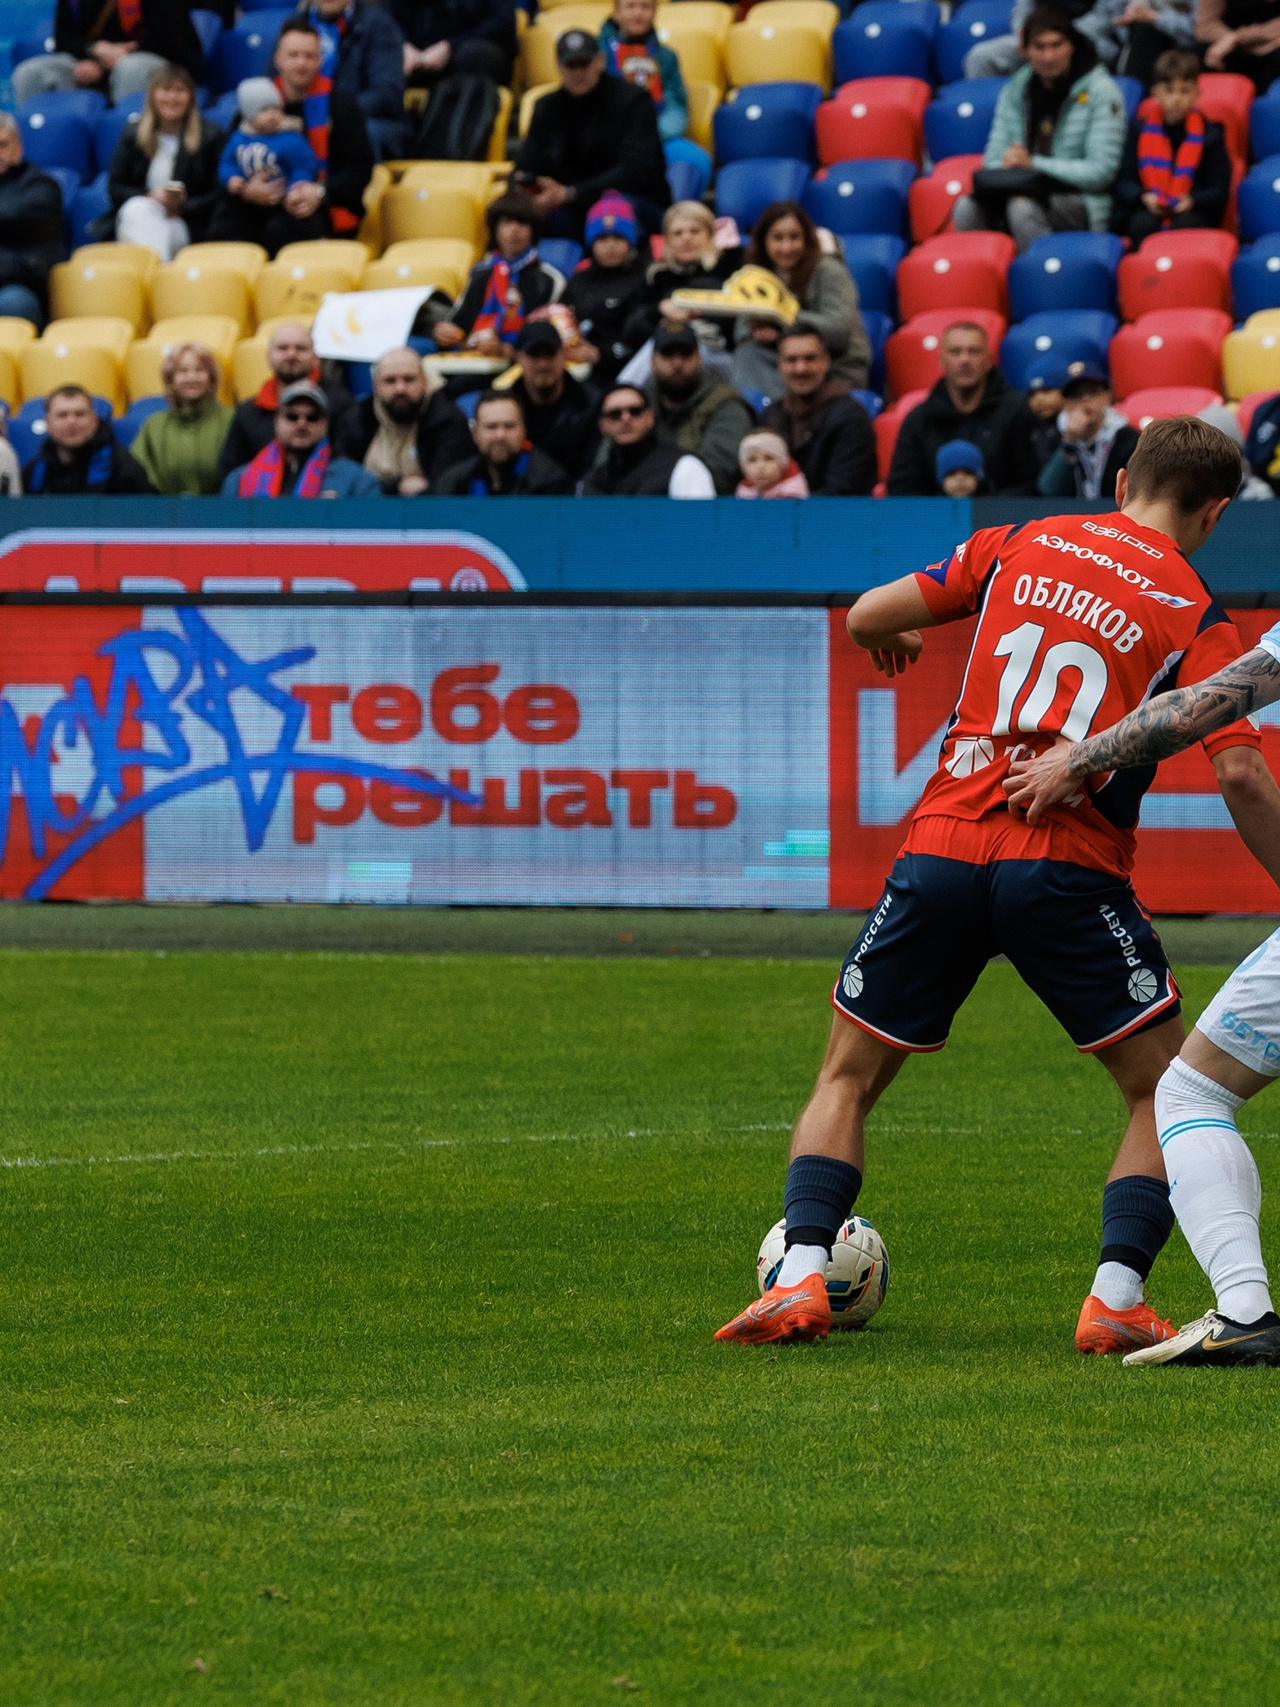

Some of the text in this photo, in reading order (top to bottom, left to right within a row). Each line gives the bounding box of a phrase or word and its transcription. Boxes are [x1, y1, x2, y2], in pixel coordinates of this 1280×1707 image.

[1031, 533, 1156, 591] АЭРОФЛОТ
[1012, 573, 1144, 654] ОБЛЯКОВ
[291, 664, 580, 745] тебе
[991, 620, 1109, 743] 10
[292, 767, 738, 845] решать
